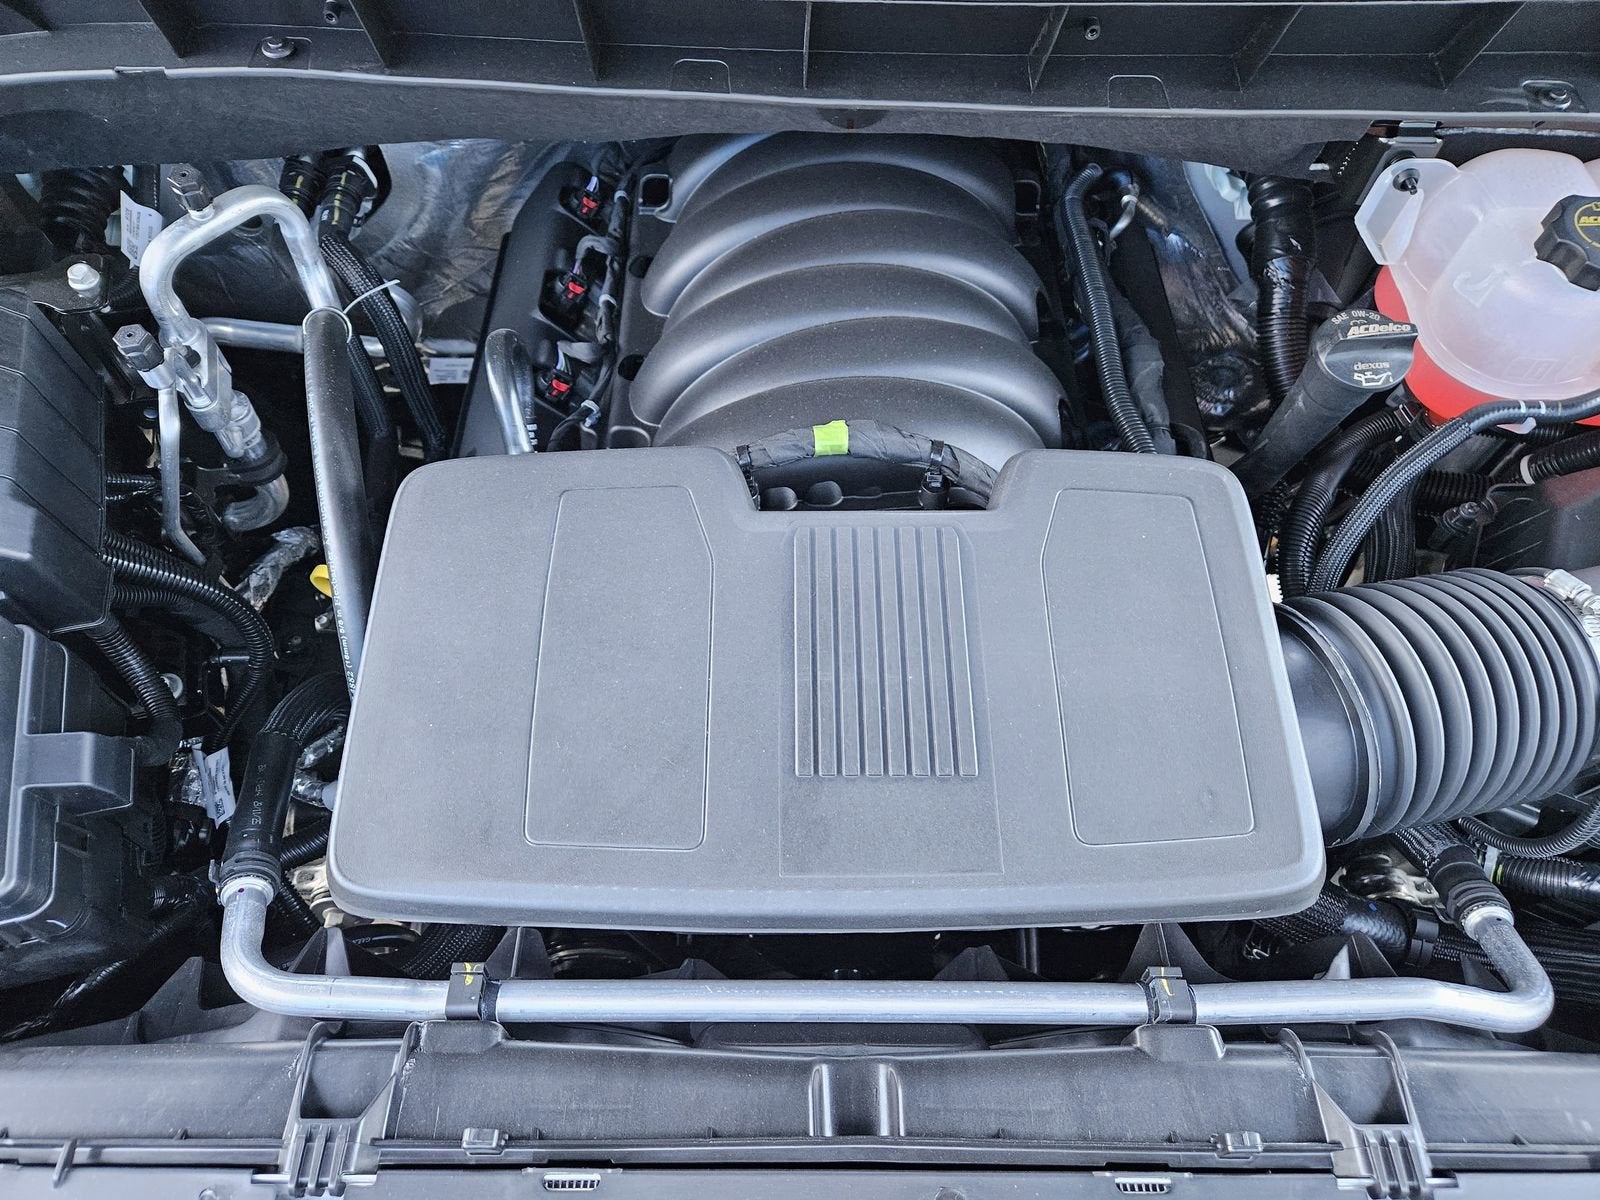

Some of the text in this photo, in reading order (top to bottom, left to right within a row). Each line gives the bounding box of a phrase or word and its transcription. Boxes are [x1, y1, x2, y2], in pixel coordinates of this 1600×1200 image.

[1331, 310, 1380, 325] SAE 0W-20
[1347, 323, 1411, 336] ACDelco
[1354, 361, 1390, 371] dexos
